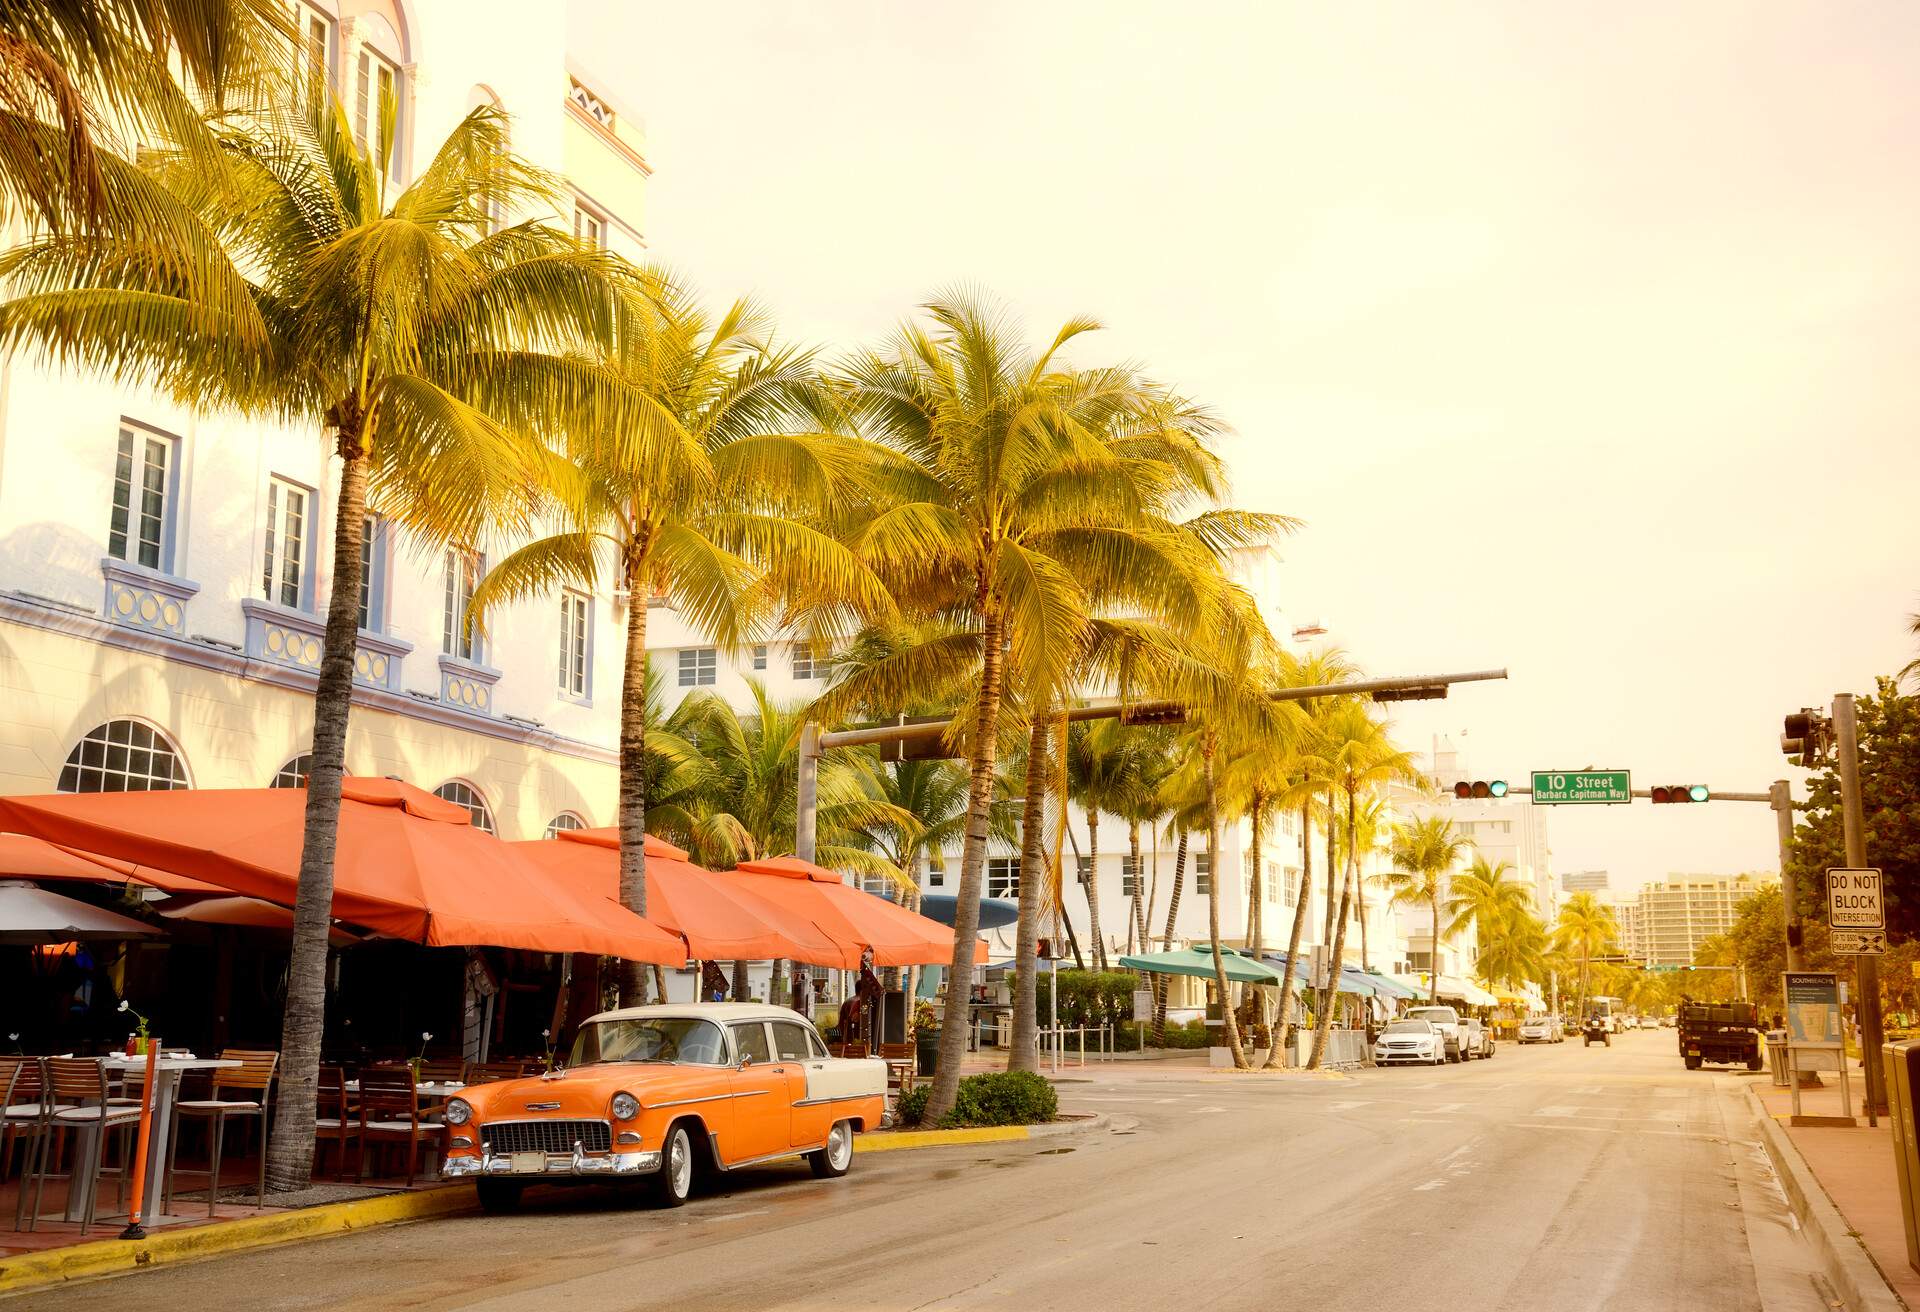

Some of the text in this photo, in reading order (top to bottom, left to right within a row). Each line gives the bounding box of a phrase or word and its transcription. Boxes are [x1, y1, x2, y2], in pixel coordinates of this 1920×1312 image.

[1547, 775, 1614, 790] 10 Street
[1536, 789, 1626, 800] Barbara Capitman Way
[1831, 875, 1877, 889] DO NOT
[1835, 895, 1876, 908] BLOCK
[1833, 912, 1881, 922] INTERSECTION
